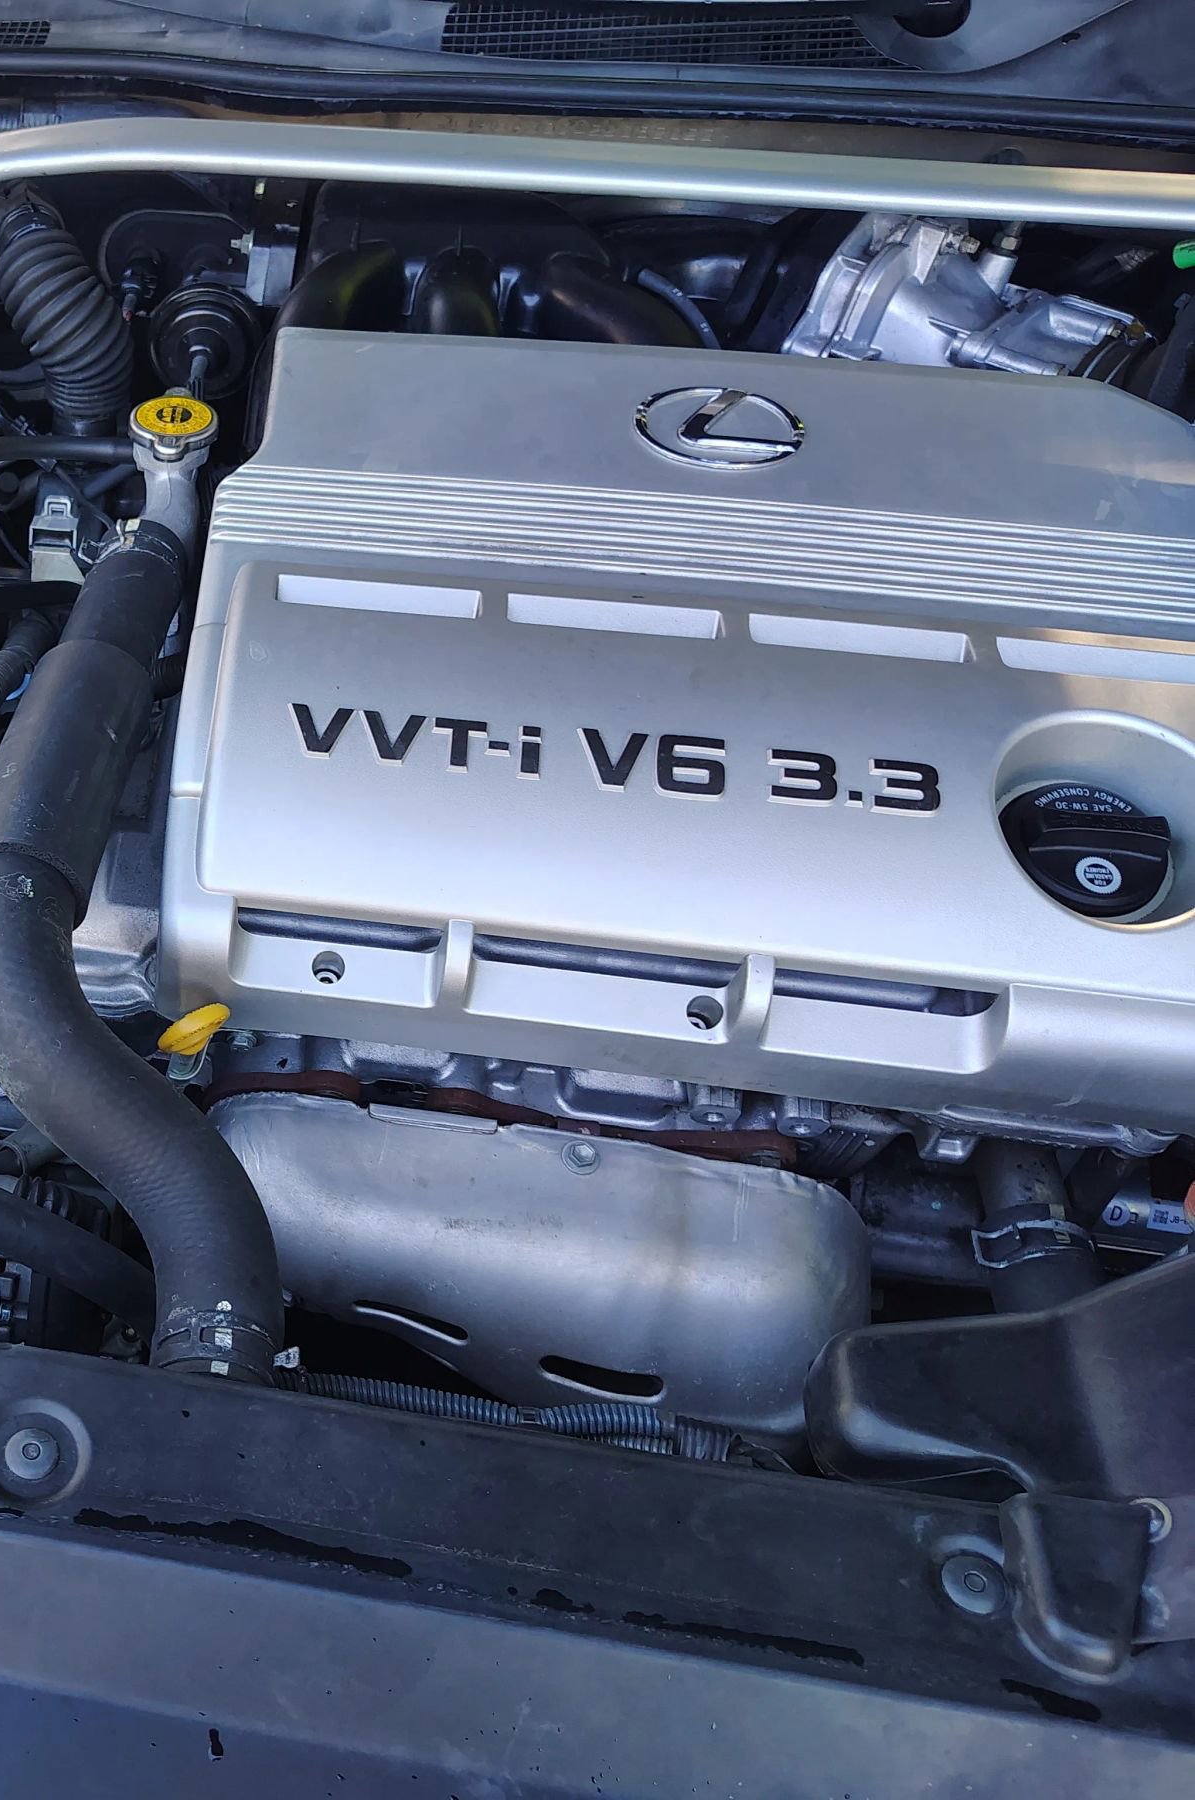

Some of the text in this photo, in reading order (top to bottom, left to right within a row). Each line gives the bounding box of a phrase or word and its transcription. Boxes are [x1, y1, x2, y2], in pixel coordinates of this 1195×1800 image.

[289, 702, 941, 818] VVT-i V6 3.3
[1034, 788, 1132, 812] ENERGY CONSERVING
[1056, 802, 1112, 812] SAE 5W-30
[1110, 1205, 1122, 1221] D
